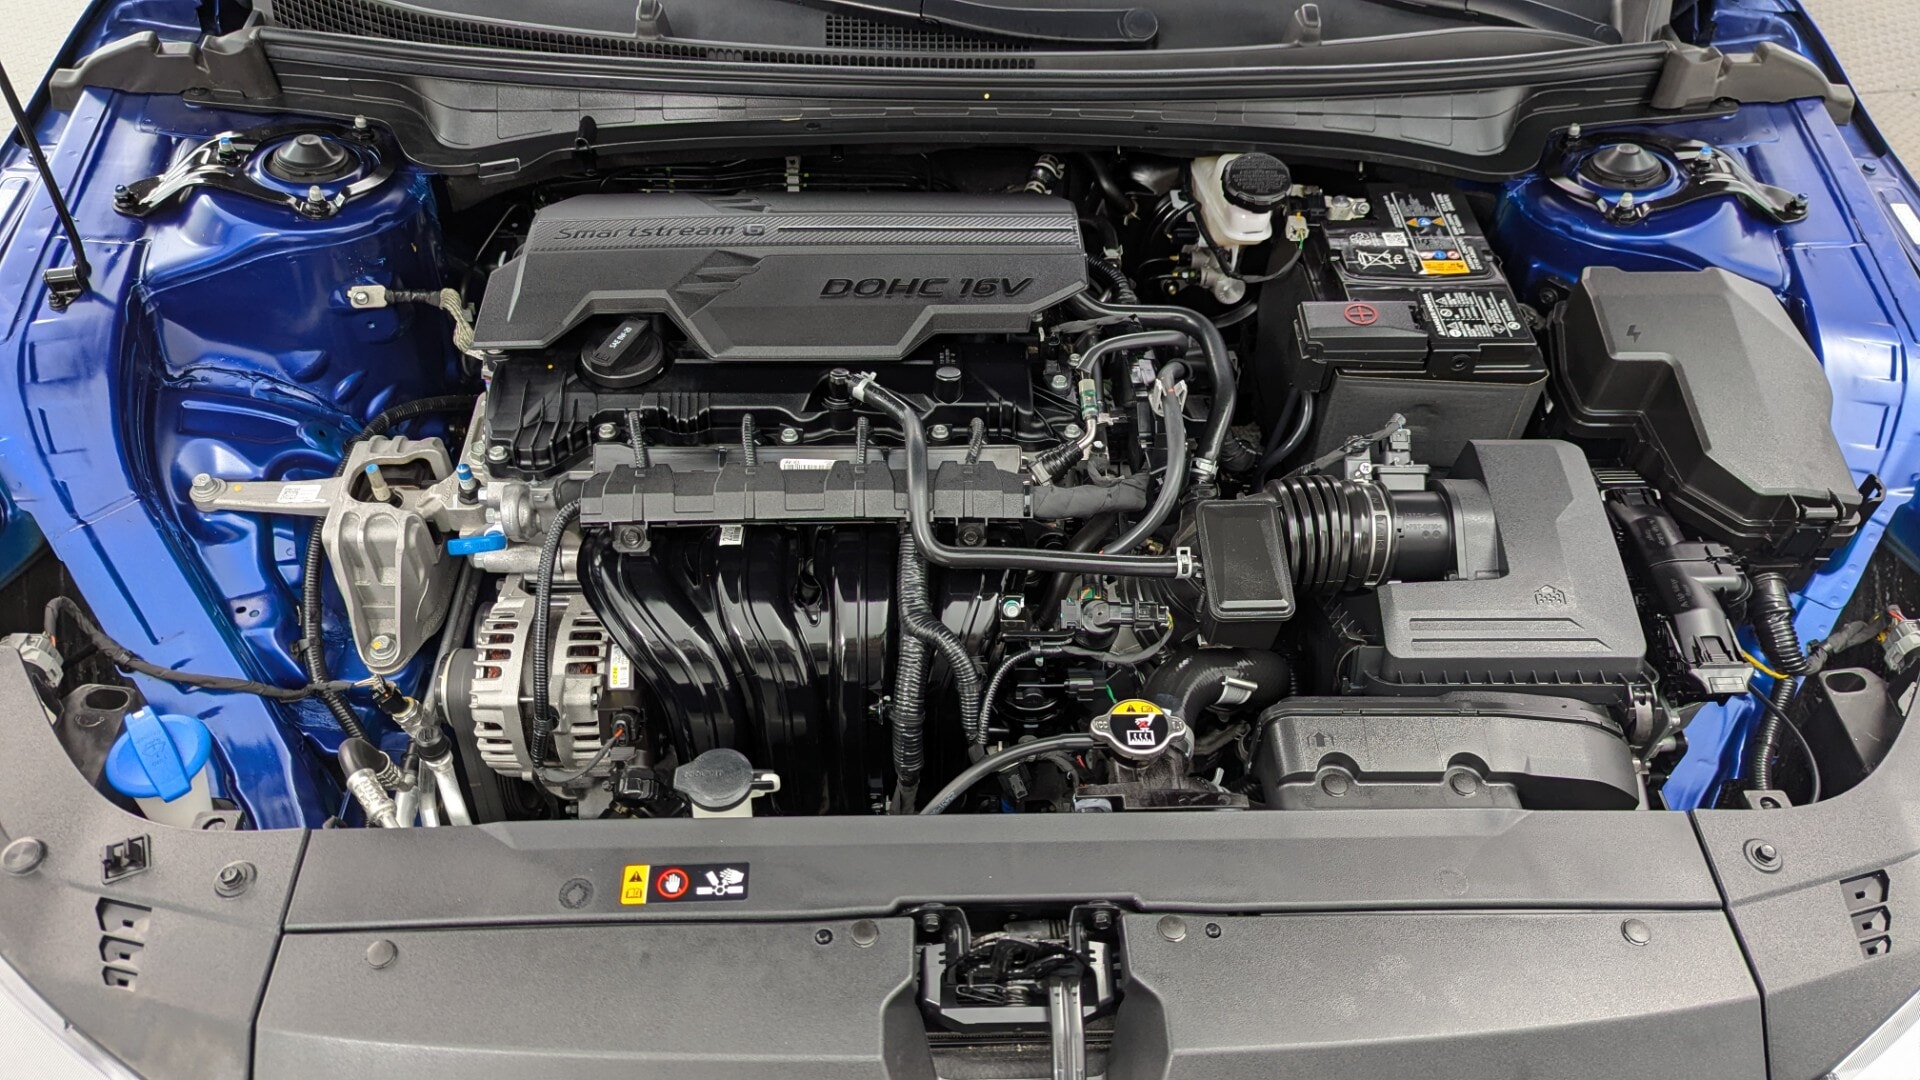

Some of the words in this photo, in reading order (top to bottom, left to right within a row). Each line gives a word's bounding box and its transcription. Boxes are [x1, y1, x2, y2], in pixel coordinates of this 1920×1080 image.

[553, 226, 736, 240] Smartstream
[819, 277, 949, 299] DOHC
[959, 277, 1035, 299] 16V
[609, 337, 622, 349] SAE
